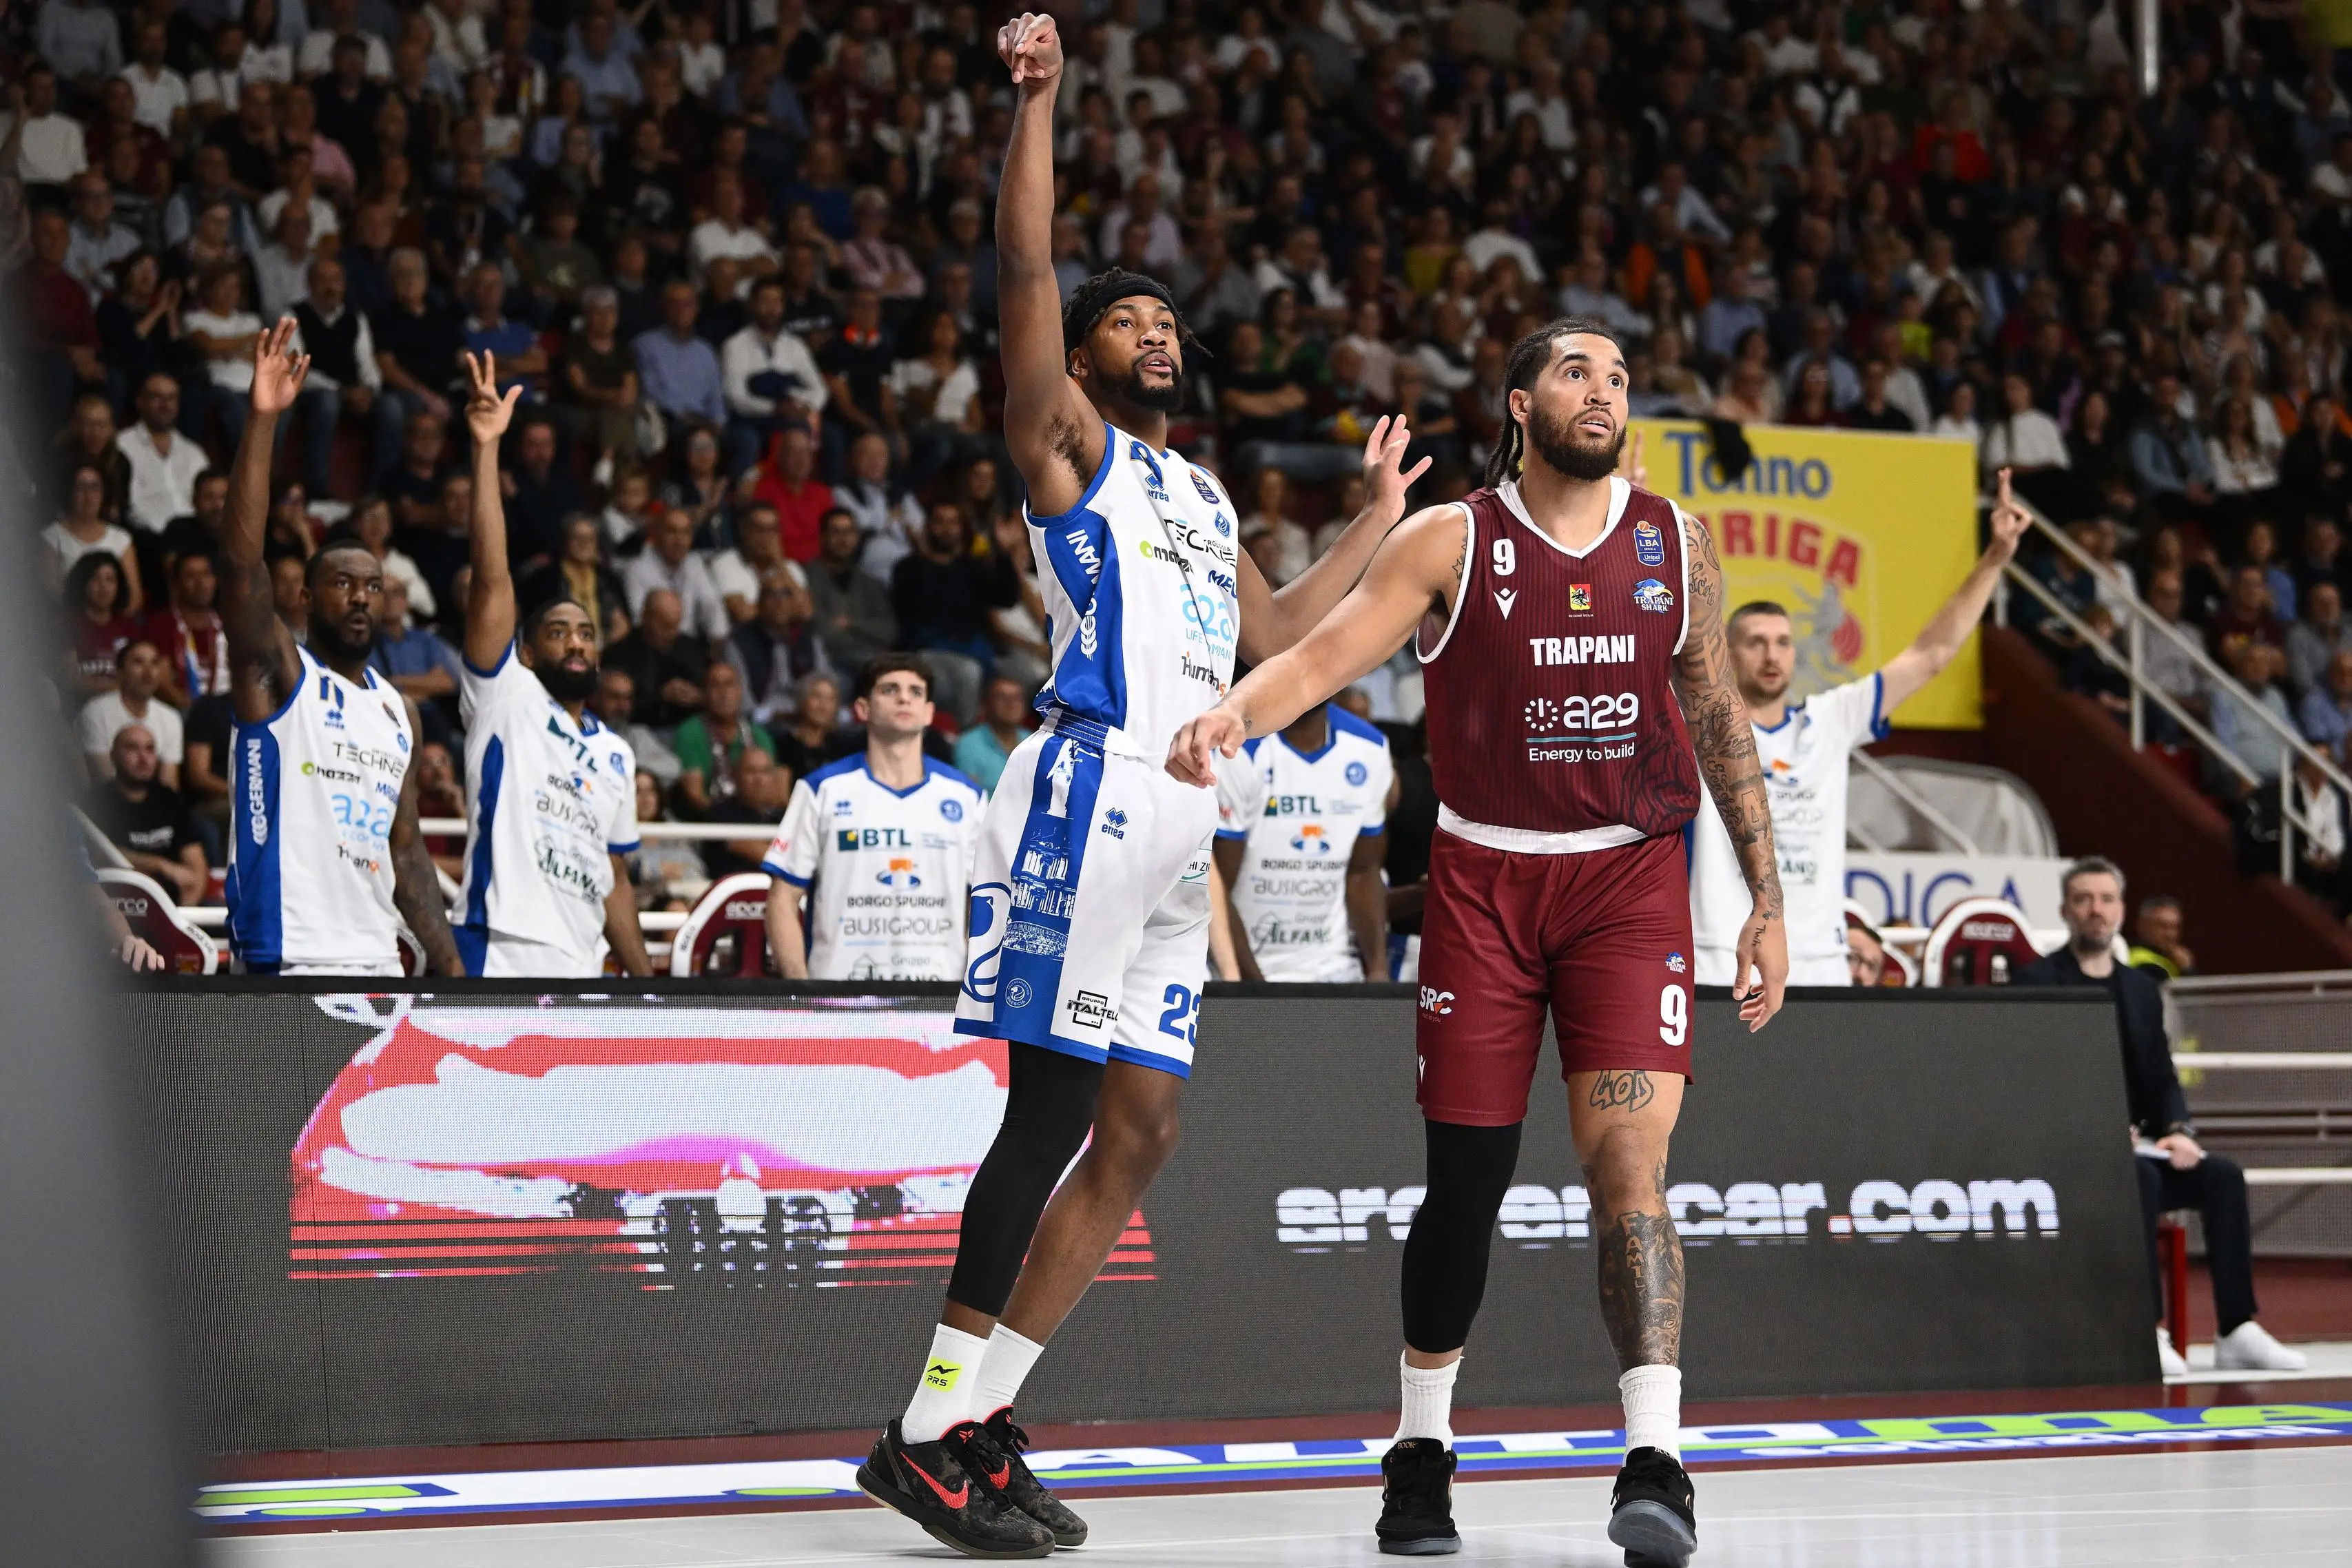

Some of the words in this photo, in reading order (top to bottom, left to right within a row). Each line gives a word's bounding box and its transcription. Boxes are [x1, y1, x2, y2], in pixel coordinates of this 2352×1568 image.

[1699, 509, 1860, 586] RIGA
[1493, 539, 1516, 576] 9
[1634, 596, 1673, 605] TRAPANI
[1641, 604, 1668, 612] SHARK
[1529, 635, 1635, 666] TRAPANI
[1563, 692, 1639, 730] a29
[1529, 748, 1583, 763] Energy
[1586, 747, 1602, 760] to
[1605, 742, 1635, 760] build
[1281, 796, 1321, 814] BTL
[863, 829, 911, 847] BTL
[1102, 823, 1124, 840] errea
[847, 896, 891, 907] BORGO
[1007, 995, 1026, 1006] BRESCIA
[1082, 996, 1104, 1005] GRUPPO
[1420, 985, 1455, 1015] SRC
[1660, 984, 1687, 1046] 9
[927, 1375, 947, 1386] PRS
